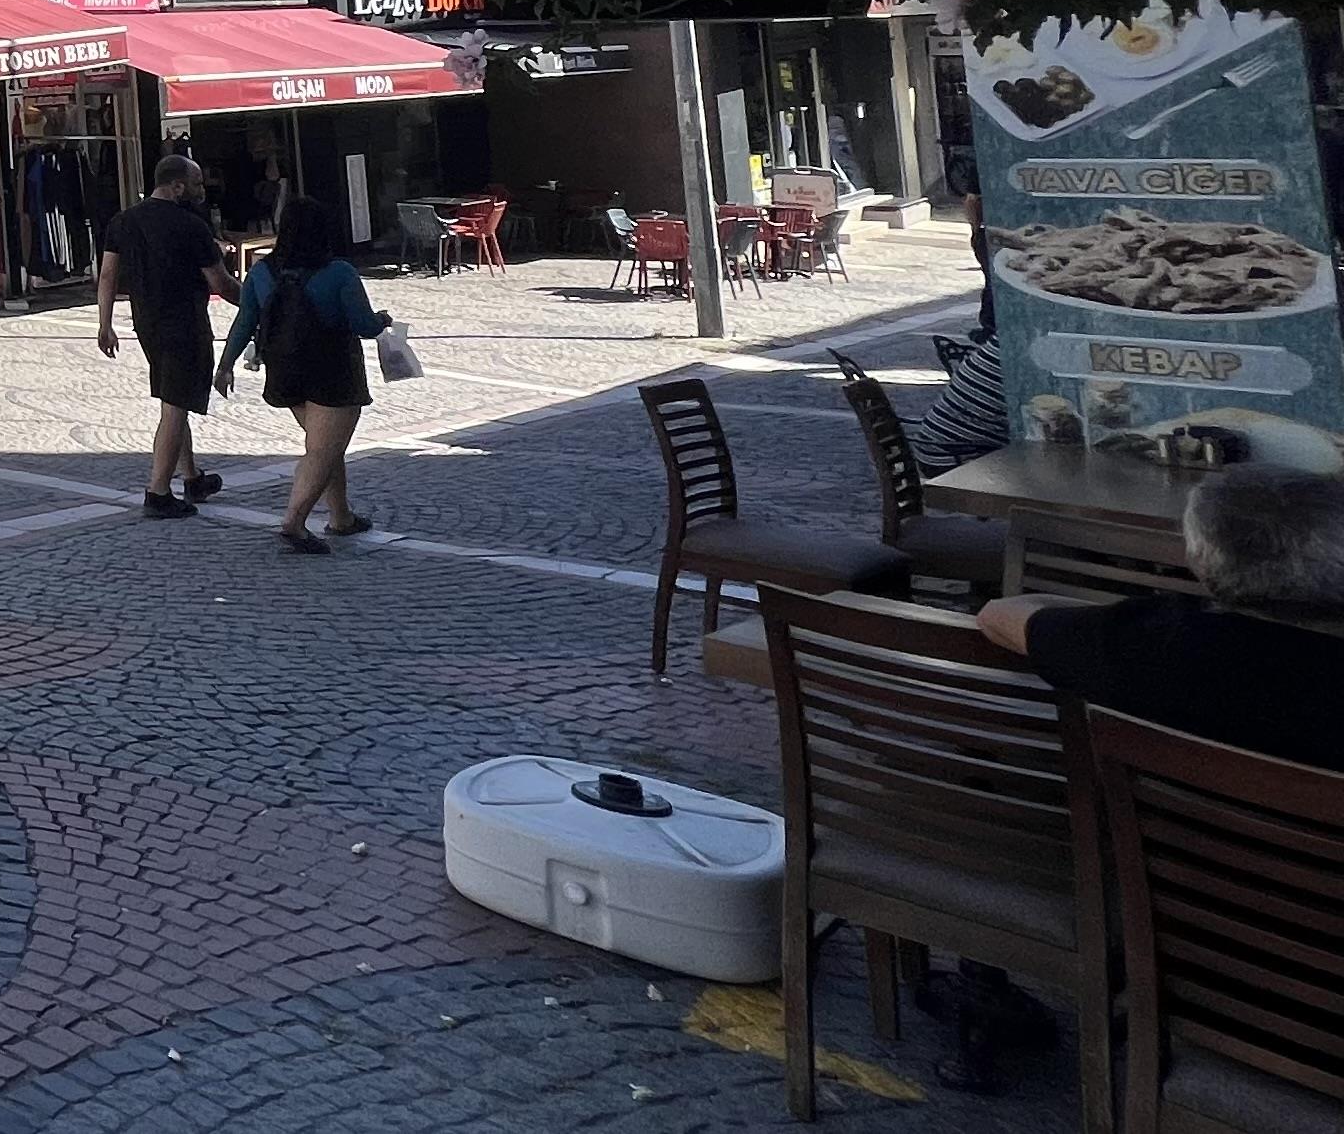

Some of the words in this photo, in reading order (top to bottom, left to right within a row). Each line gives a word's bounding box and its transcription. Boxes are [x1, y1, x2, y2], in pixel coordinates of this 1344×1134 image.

[64, 40, 111, 65] BEBE
[272, 77, 326, 103] GÜLŞAH
[356, 75, 394, 95] MODA
[1017, 168, 1128, 195] TAVA
[1140, 162, 1279, 196] CİĞER
[1090, 342, 1243, 380] KEBAP
